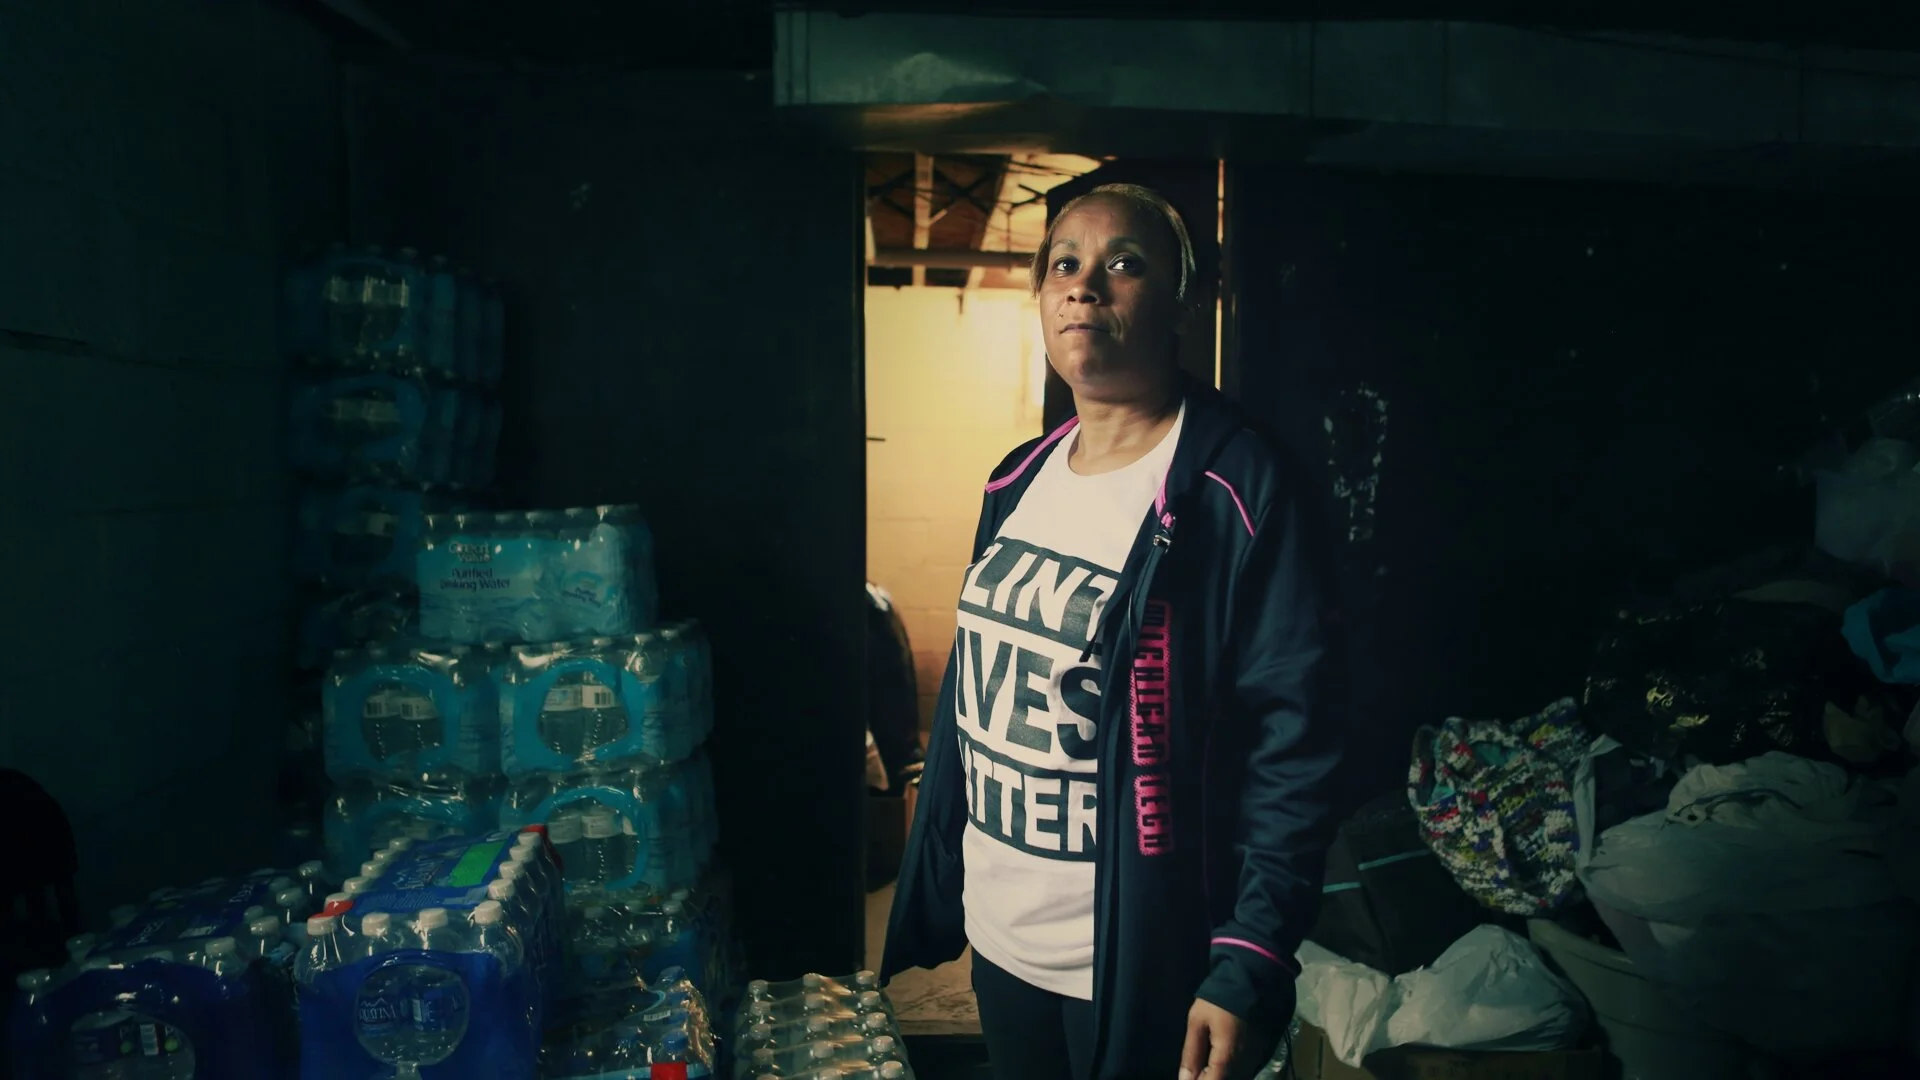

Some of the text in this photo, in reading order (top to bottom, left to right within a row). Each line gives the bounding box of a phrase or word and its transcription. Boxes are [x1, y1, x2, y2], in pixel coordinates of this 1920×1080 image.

[961, 542, 1119, 643] LINT
[957, 626, 1102, 761] IVES
[964, 740, 1098, 853] TTER
